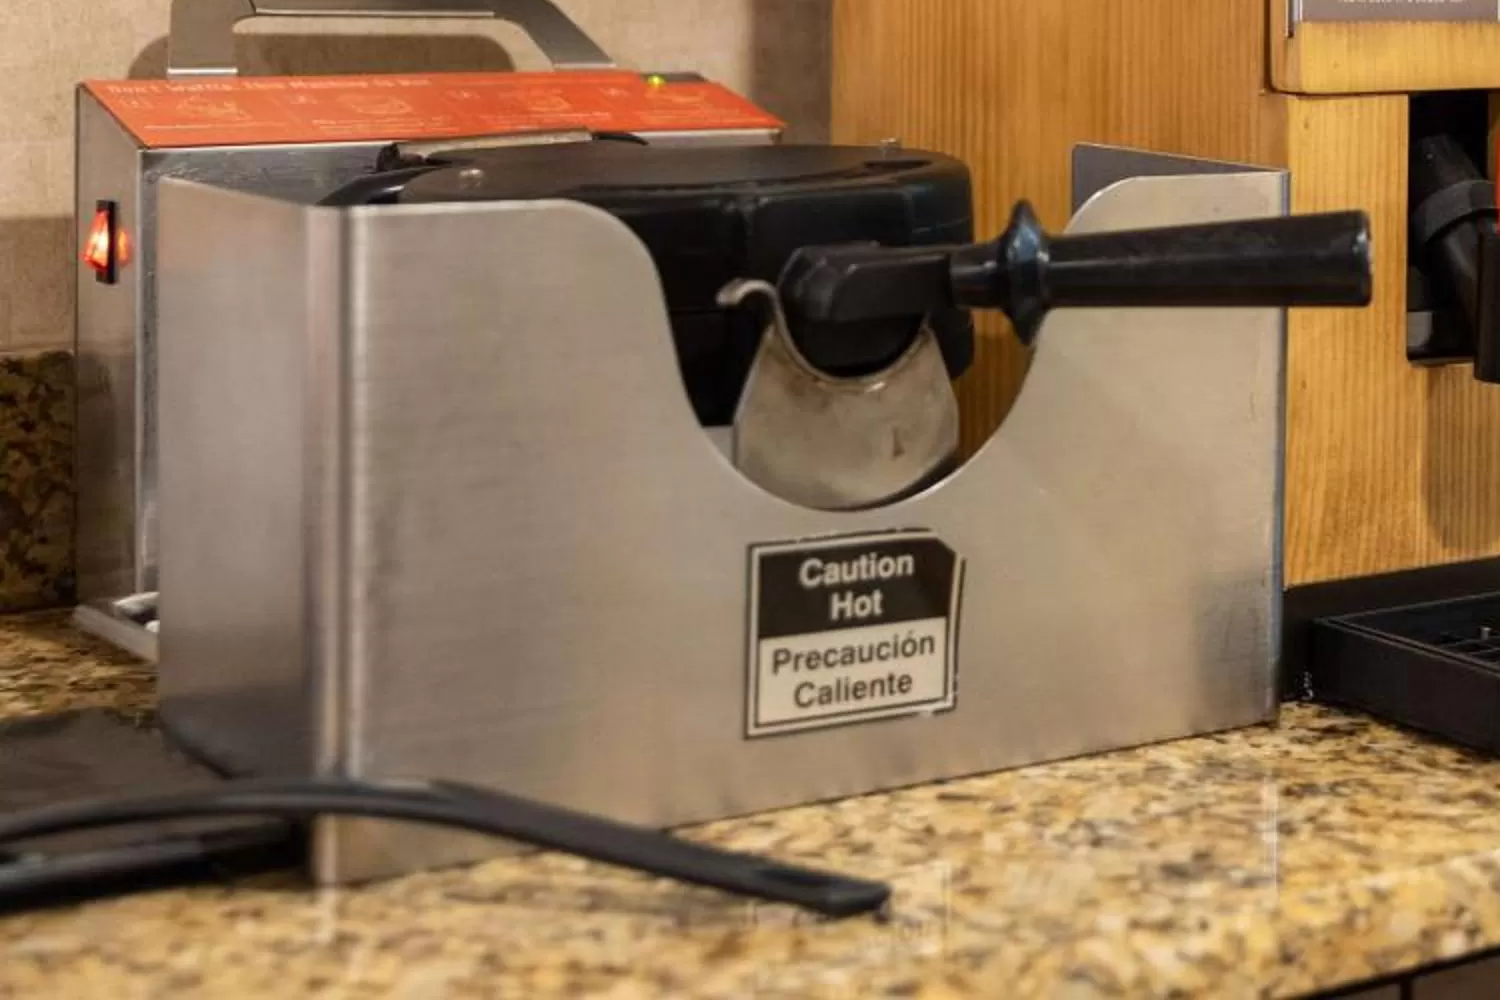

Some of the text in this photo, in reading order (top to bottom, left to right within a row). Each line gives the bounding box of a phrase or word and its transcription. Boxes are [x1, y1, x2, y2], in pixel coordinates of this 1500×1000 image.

[799, 552, 914, 588] Caution
[830, 588, 883, 620] Hot
[771, 630, 936, 675] Precaución
[793, 673, 913, 708] Caliente
